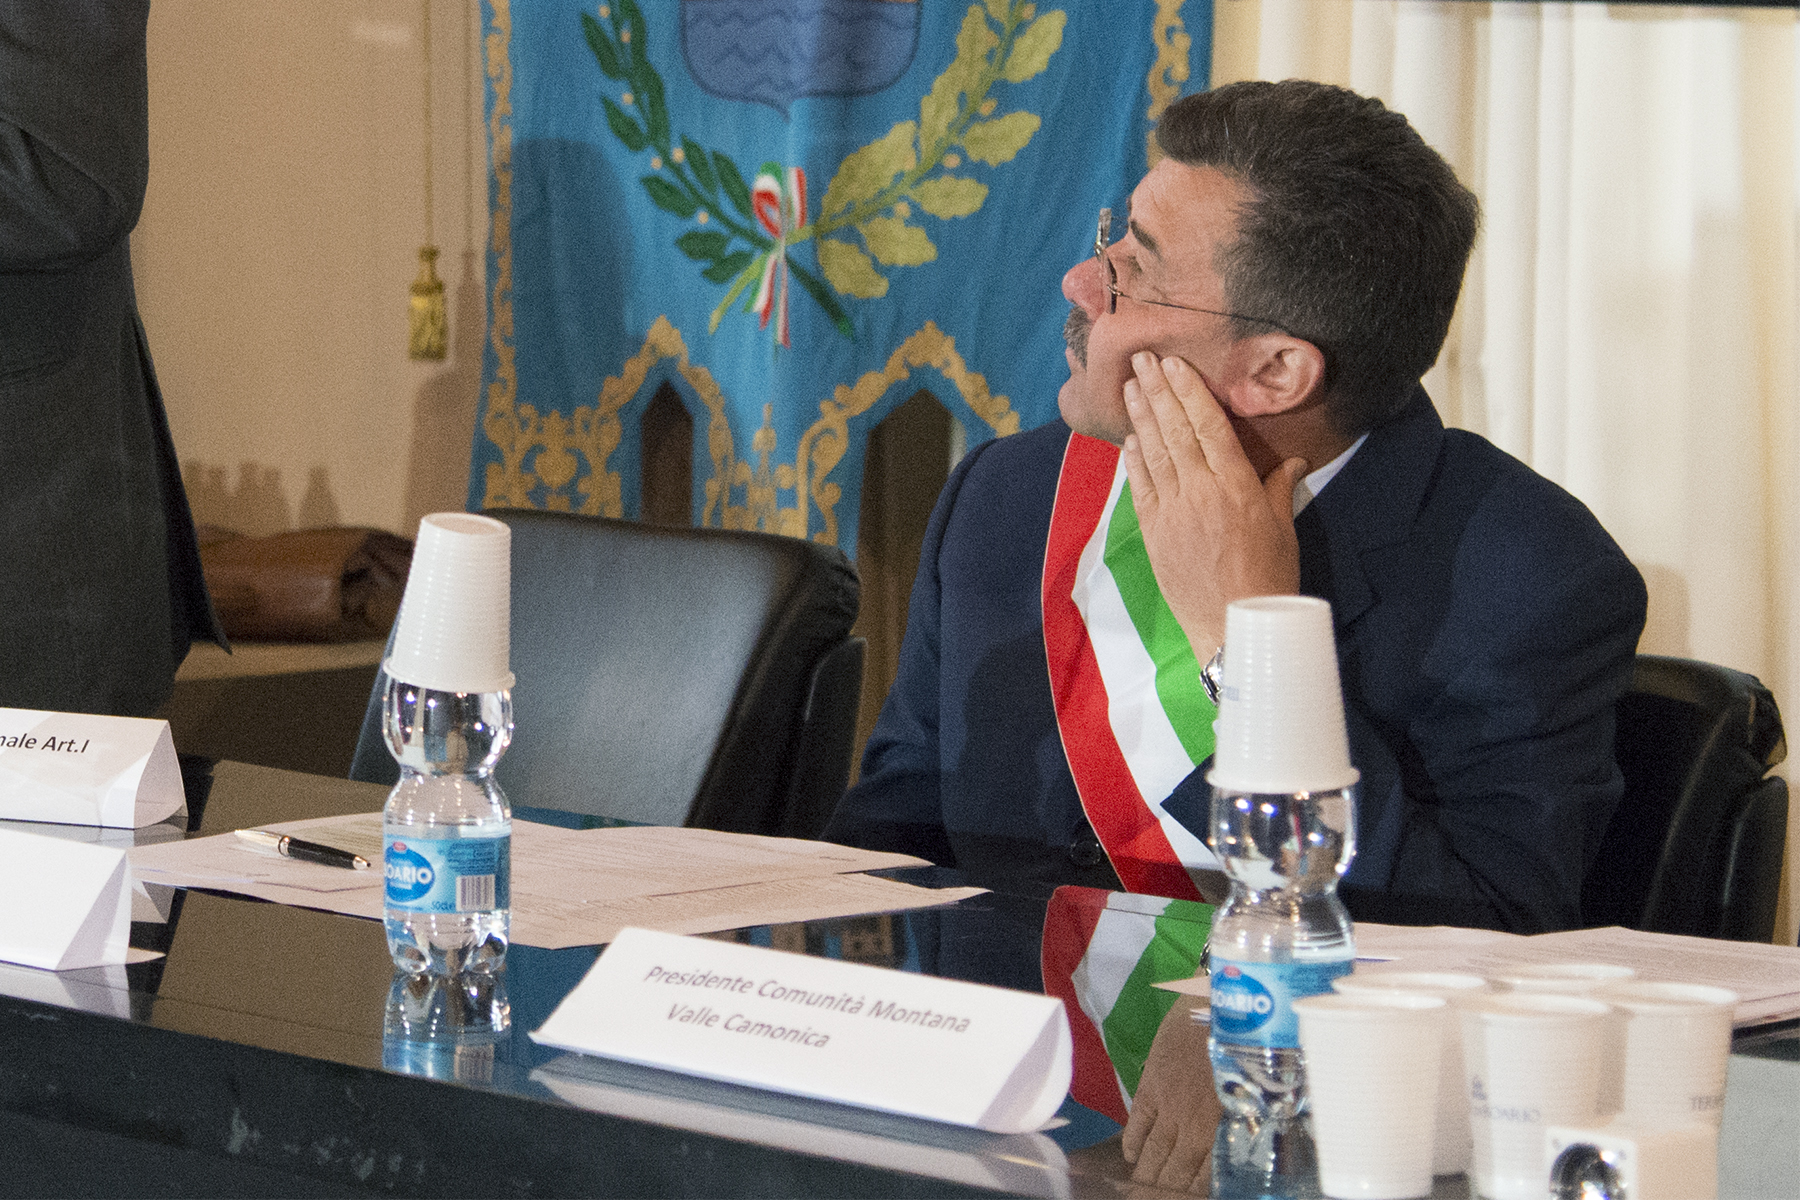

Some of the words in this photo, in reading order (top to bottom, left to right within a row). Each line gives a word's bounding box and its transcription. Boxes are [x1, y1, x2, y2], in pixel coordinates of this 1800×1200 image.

[42, 736, 90, 754] Art.I
[384, 863, 433, 884] OARIO
[644, 965, 754, 994] Presidente
[758, 979, 865, 1014] Comunità
[868, 1000, 972, 1033] Montana
[1211, 988, 1272, 1015] OARIO
[668, 1003, 721, 1028] Valle
[723, 1013, 831, 1048] Camonica
